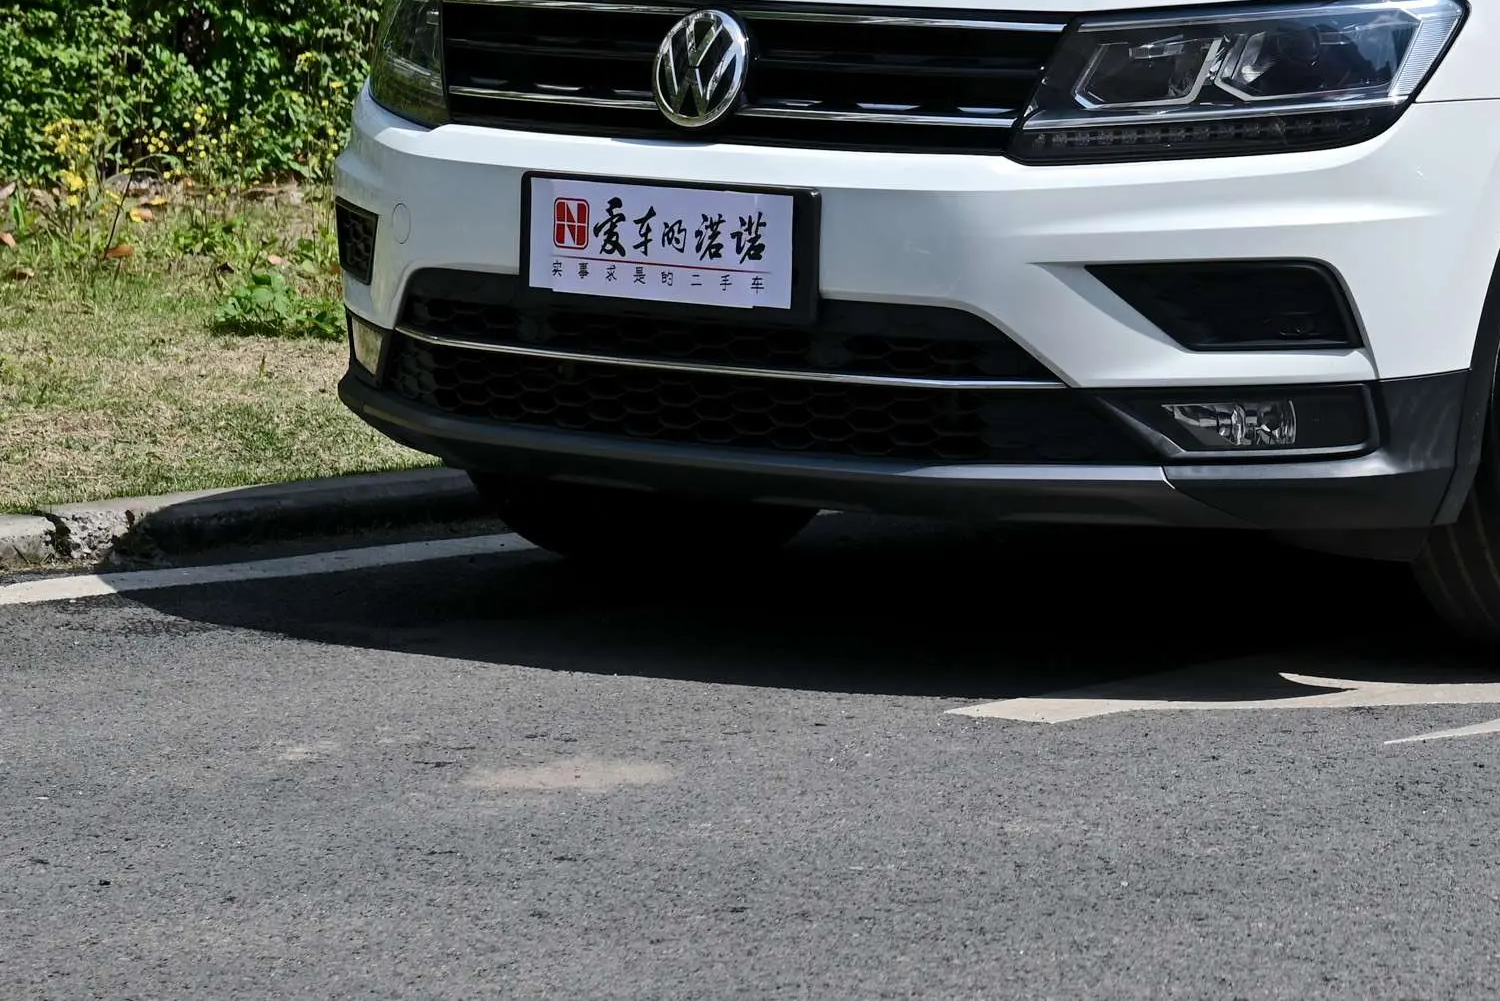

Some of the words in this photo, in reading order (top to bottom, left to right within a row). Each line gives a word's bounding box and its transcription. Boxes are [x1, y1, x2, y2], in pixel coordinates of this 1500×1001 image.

[551, 259, 765, 294] 实事求是的二手车
